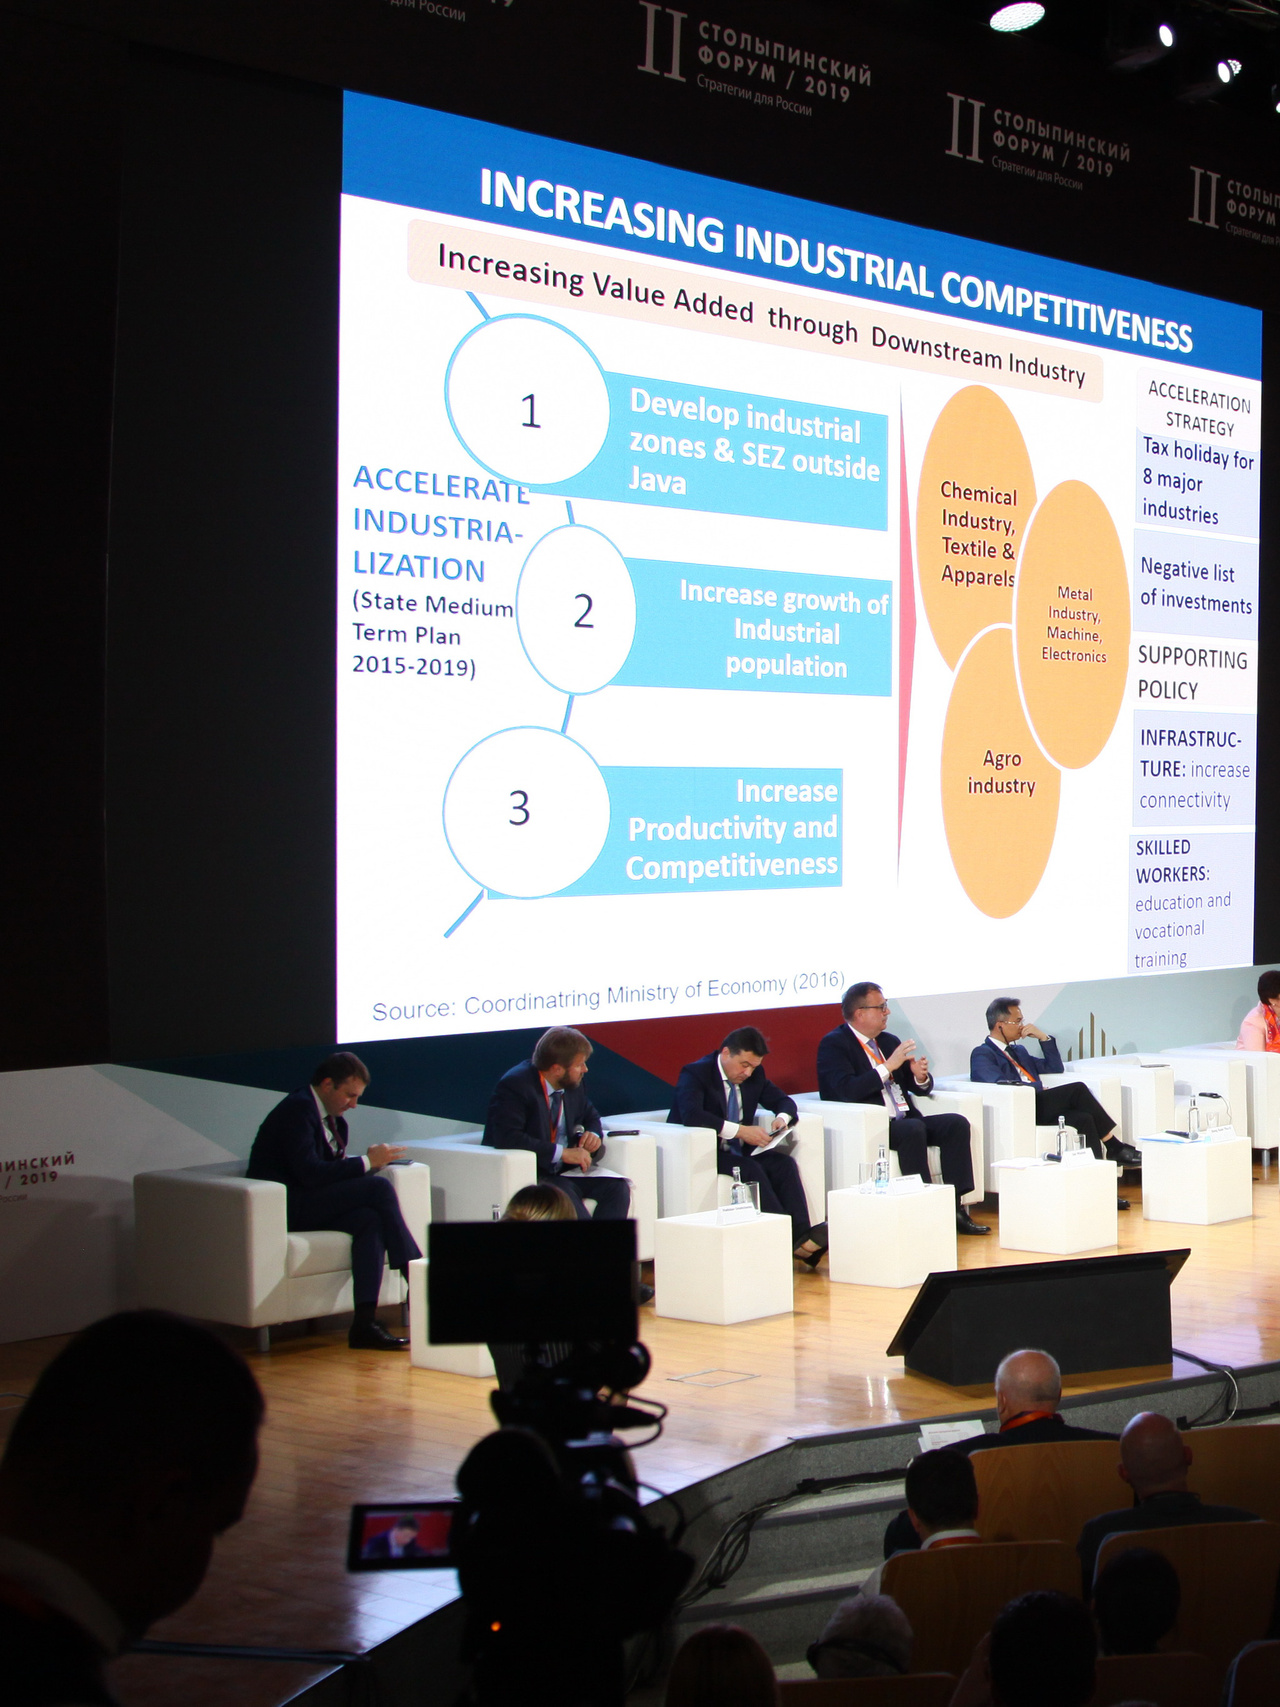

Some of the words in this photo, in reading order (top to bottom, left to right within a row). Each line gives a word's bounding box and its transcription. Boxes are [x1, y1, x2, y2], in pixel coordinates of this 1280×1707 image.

[419, 0, 467, 23] России
[637, 0, 688, 83] II
[699, 20, 872, 87] СТОЛЫПИНСКИЙ
[698, 45, 776, 83] ФОРУМ
[785, 70, 795, 91] /
[805, 75, 851, 103] 2019
[696, 73, 752, 100] Стратегии
[753, 92, 774, 107] для
[776, 96, 813, 117] России
[944, 91, 986, 165] II
[993, 108, 1131, 163] СТОЛЫПИНСКИЙ
[992, 129, 1055, 162] ФОРУМ
[1061, 149, 1070, 168] /
[1077, 154, 1114, 178] 2019
[991, 155, 1036, 178] Стратегии
[1036, 169, 1053, 182] для
[1053, 171, 1084, 191] России
[1188, 165, 1222, 230] II
[1226, 198, 1277, 227] ФОРУМ
[1225, 221, 1261, 242] Стратегии
[479, 167, 726, 254] INCREASING
[735, 223, 934, 300] INDUSTRIAL
[940, 270, 1194, 355] COMPETITIVENESS
[438, 242, 584, 297] Increasing
[592, 272, 665, 307] Value
[673, 288, 754, 324] Added
[768, 306, 859, 344] through
[871, 325, 1003, 370] Downstream
[1007, 351, 1087, 390] Industry
[520, 393, 542, 429] 1
[1149, 380, 1251, 414] ACCELERATION
[630, 387, 740, 430] Develop
[746, 401, 862, 445] industrial
[1166, 411, 1235, 437] STRATEGY
[629, 430, 707, 460] zones
[713, 436, 735, 464] &
[741, 441, 786, 471] SEZ
[792, 447, 881, 484] outside
[1143, 436, 1169, 456] Tax
[1174, 440, 1229, 470] holiday
[1234, 450, 1255, 470] for
[353, 465, 531, 505] ACCELERATE
[627, 465, 687, 495] Java
[940, 480, 1018, 507] Chemical
[1143, 467, 1152, 484] 8
[1157, 471, 1203, 494] major
[353, 508, 524, 544] INDUSTRIA-
[942, 508, 1016, 537] Industry,
[1143, 498, 1219, 525] industries
[942, 536, 997, 560] Textile
[1002, 543, 1016, 560] &
[353, 550, 486, 583] LIZATION
[941, 564, 1016, 589] Apparels
[1141, 556, 1209, 581] Negative
[1213, 563, 1235, 583] list
[353, 589, 418, 614] (State
[426, 595, 515, 620] Medium
[680, 578, 777, 609] Increase
[783, 583, 861, 618] growth
[867, 593, 890, 617] of
[1057, 585, 1093, 602] Metal
[1140, 588, 1157, 606] of
[1162, 589, 1253, 615] investments
[573, 593, 595, 630] 2
[1049, 605, 1102, 625] Industry,
[352, 622, 408, 644] Term
[415, 624, 462, 647] Plan
[734, 617, 841, 646] Industrial
[1047, 625, 1103, 645] Machine,
[352, 655, 477, 681] 2015-2019)
[726, 650, 848, 680] population
[1041, 646, 1107, 664] Electronics
[1138, 645, 1248, 670] SUPPORTING
[1138, 679, 1198, 700] POLICY
[1141, 729, 1242, 748] INFRASTRUC-
[983, 750, 1022, 771] Agro
[1140, 760, 1186, 778] TURE:
[1190, 760, 1250, 779] increase
[737, 778, 838, 804] Increase
[968, 775, 1036, 797] industry
[508, 789, 531, 826] 3
[1139, 790, 1231, 812] connectivity
[629, 815, 787, 845] Productivity
[793, 813, 838, 840] and
[1136, 838, 1191, 856] SKILLED
[625, 853, 839, 883] Competitiveness
[1136, 865, 1210, 884] WORKERS:
[1135, 893, 1203, 912] education
[1207, 891, 1231, 908] and
[1135, 919, 1205, 940] vocational
[1135, 951, 1187, 969] training
[372, 999, 456, 1022] Source:
[464, 988, 600, 1016] Coordinatring
[607, 980, 679, 1006] Ministry
[685, 979, 701, 998] of
[708, 974, 788, 999] Economy
[793, 970, 845, 993] (2016)
[20, 1171, 58, 1186] 2019
